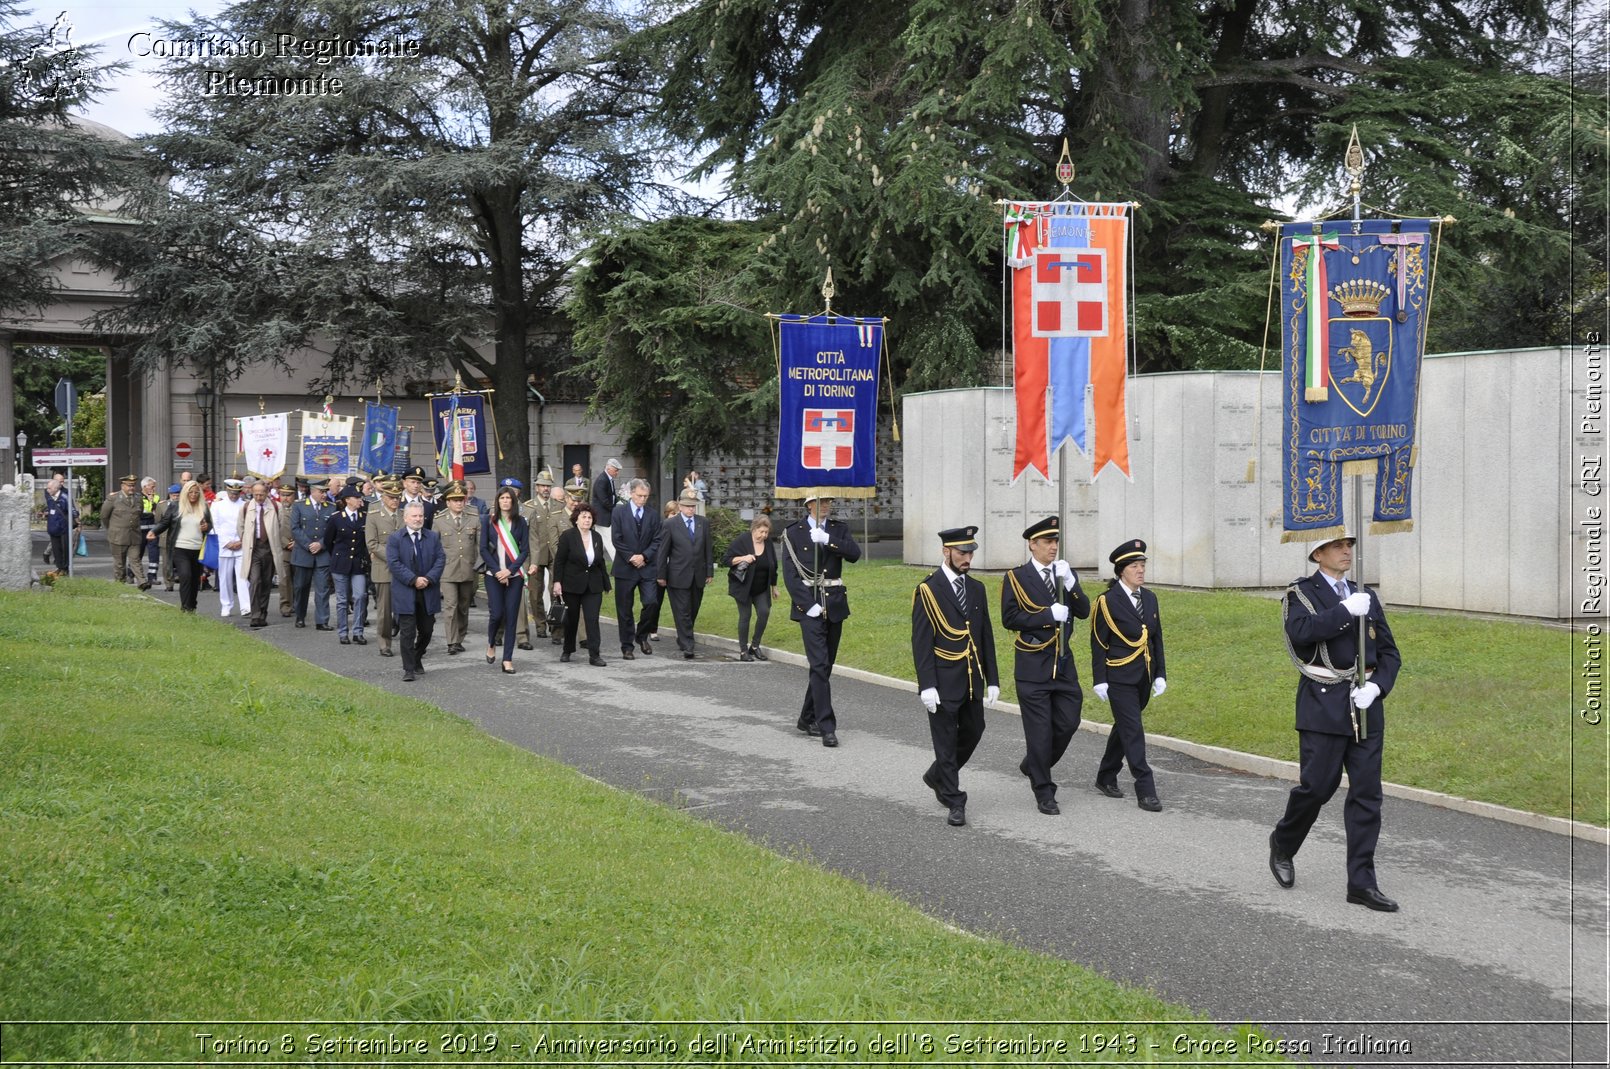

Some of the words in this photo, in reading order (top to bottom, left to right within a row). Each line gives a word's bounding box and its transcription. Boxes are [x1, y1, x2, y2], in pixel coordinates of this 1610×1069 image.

[816, 350, 846, 365] CITTÀ
[788, 367, 874, 382] METROPOLITANA
[804, 384, 815, 397] DI
[819, 384, 856, 398] TORINO
[1355, 425, 1366, 441] DI
[1370, 423, 1407, 440] TORINO
